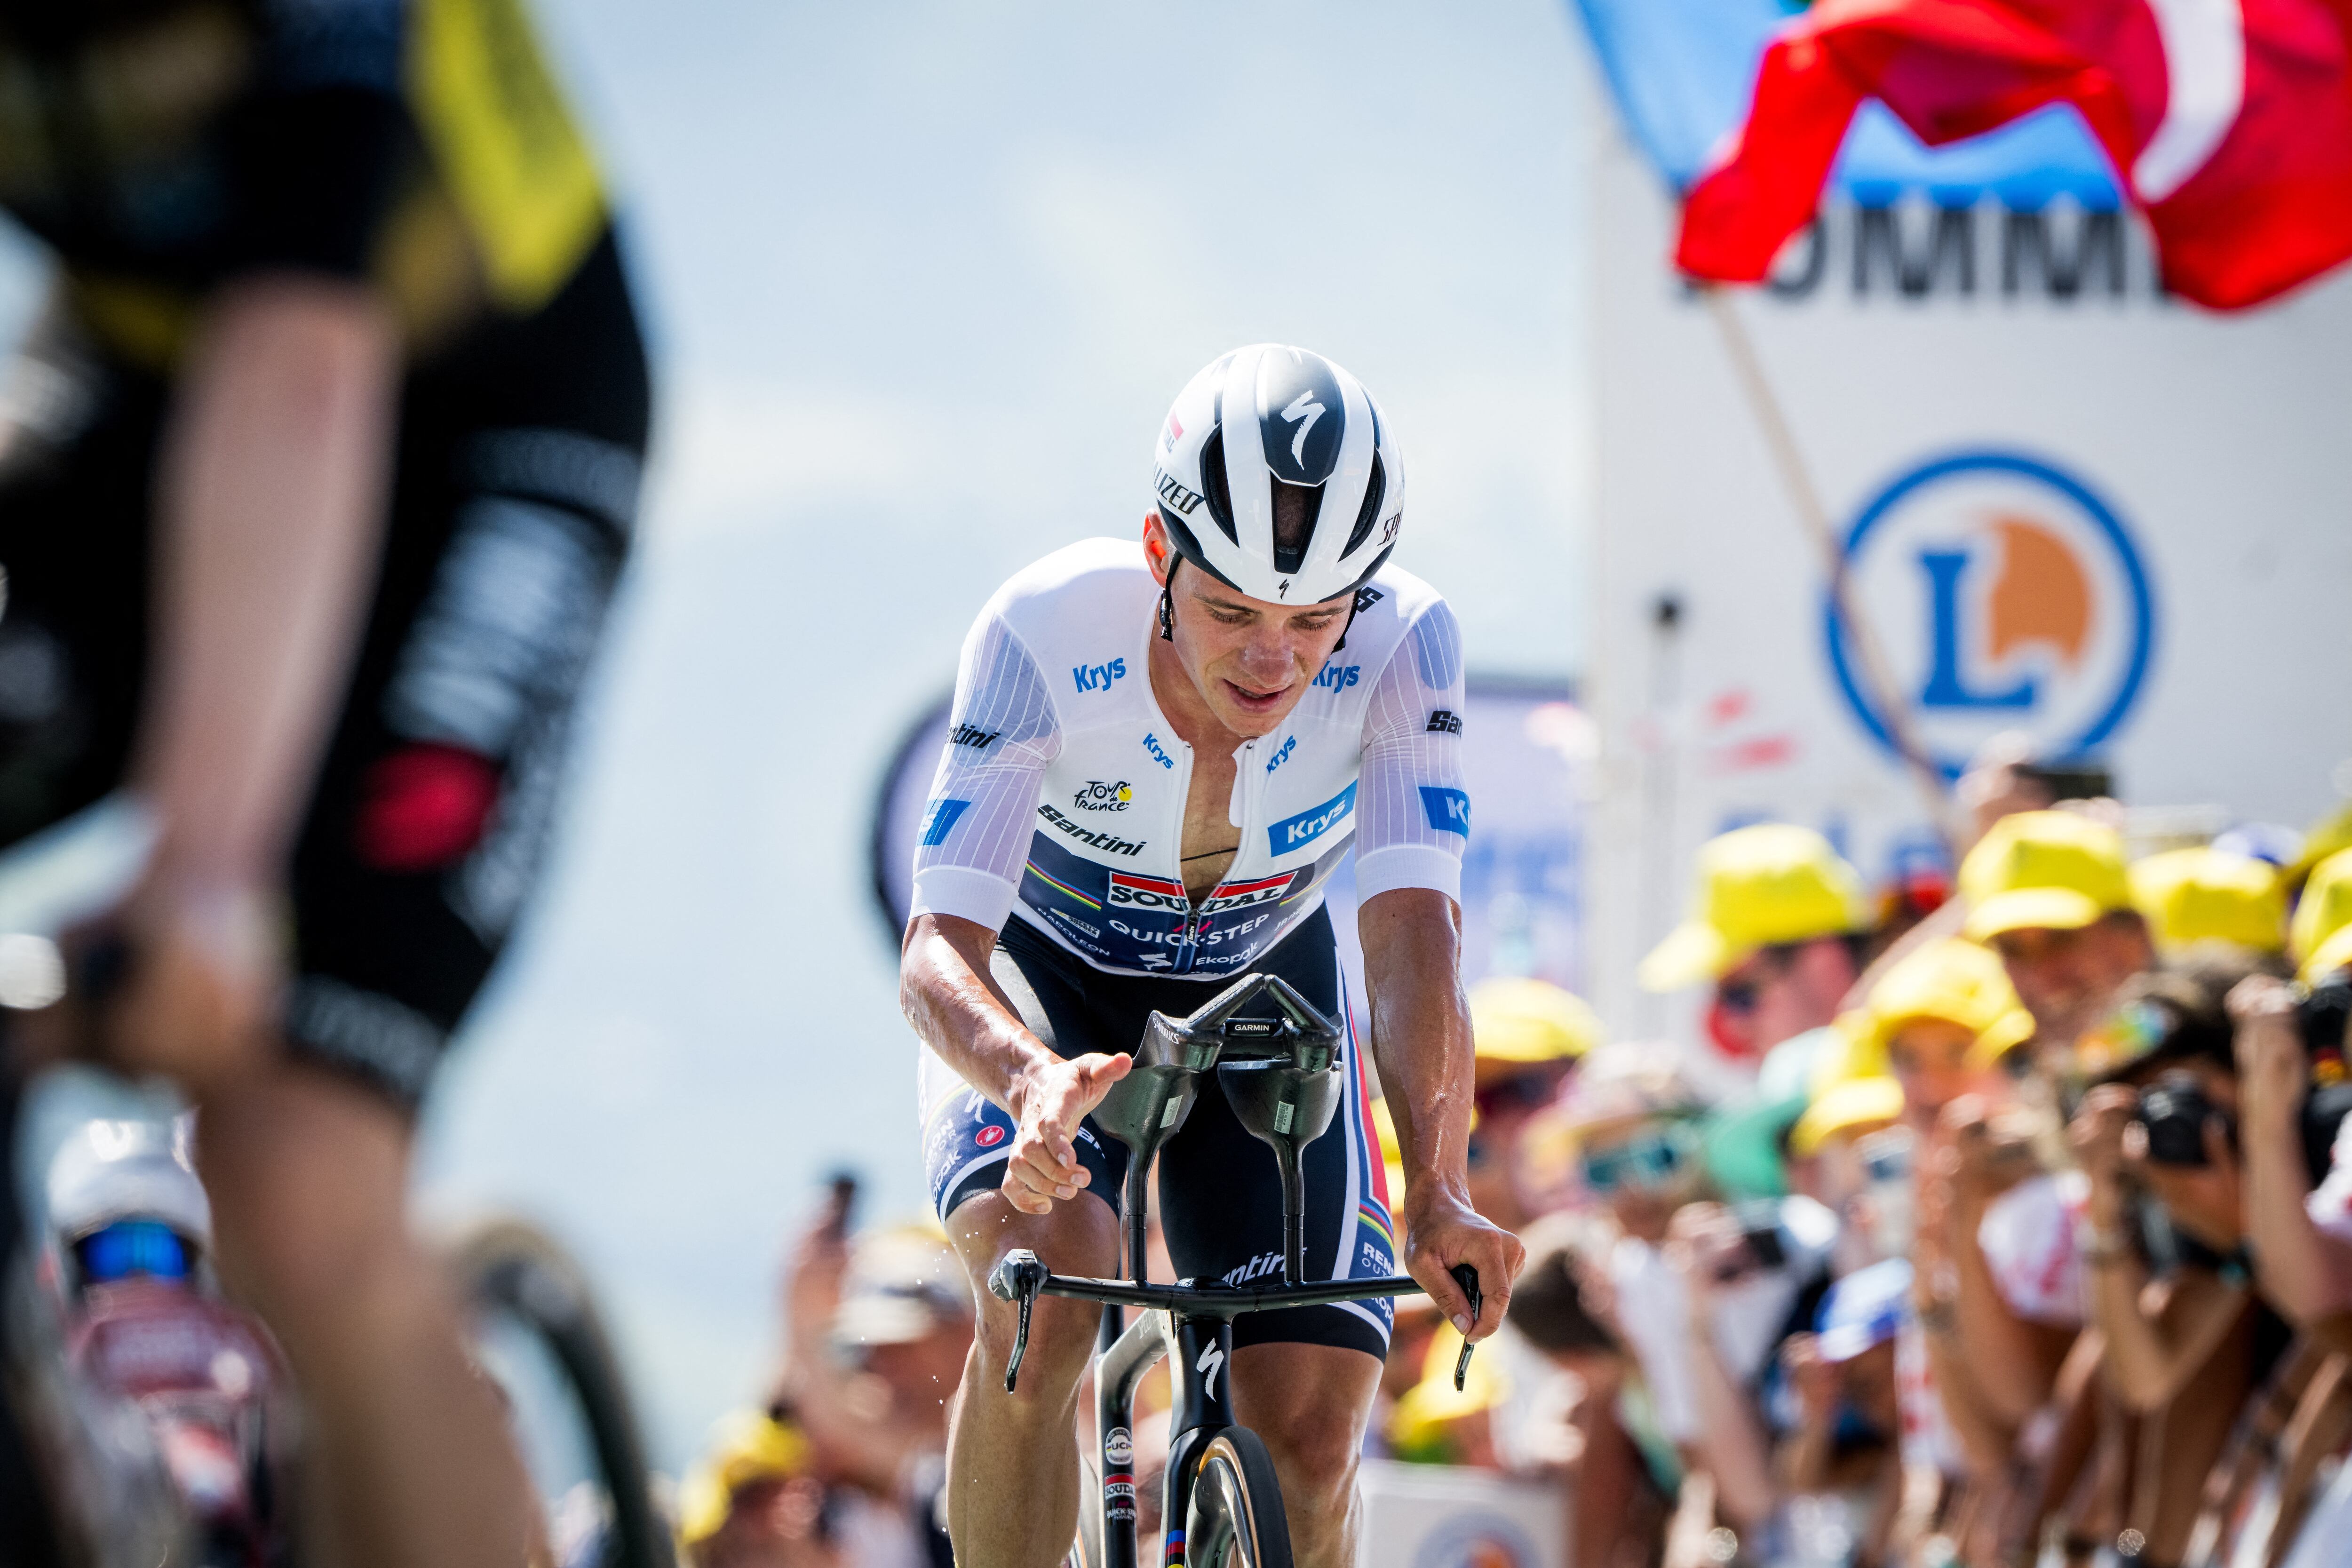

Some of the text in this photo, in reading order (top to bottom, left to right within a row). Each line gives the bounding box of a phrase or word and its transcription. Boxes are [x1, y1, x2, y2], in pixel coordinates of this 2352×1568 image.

[1073, 657, 1126, 693] Krys
[1143, 732, 1174, 769] Krys
[1038, 804, 1147, 856] Santini
[1287, 799, 1346, 844] Krys
[1111, 886, 1282, 913] SOUDAL
[1038, 907, 1111, 956] NAPOLEON
[1153, 1017, 1180, 1045] S-WORKS
